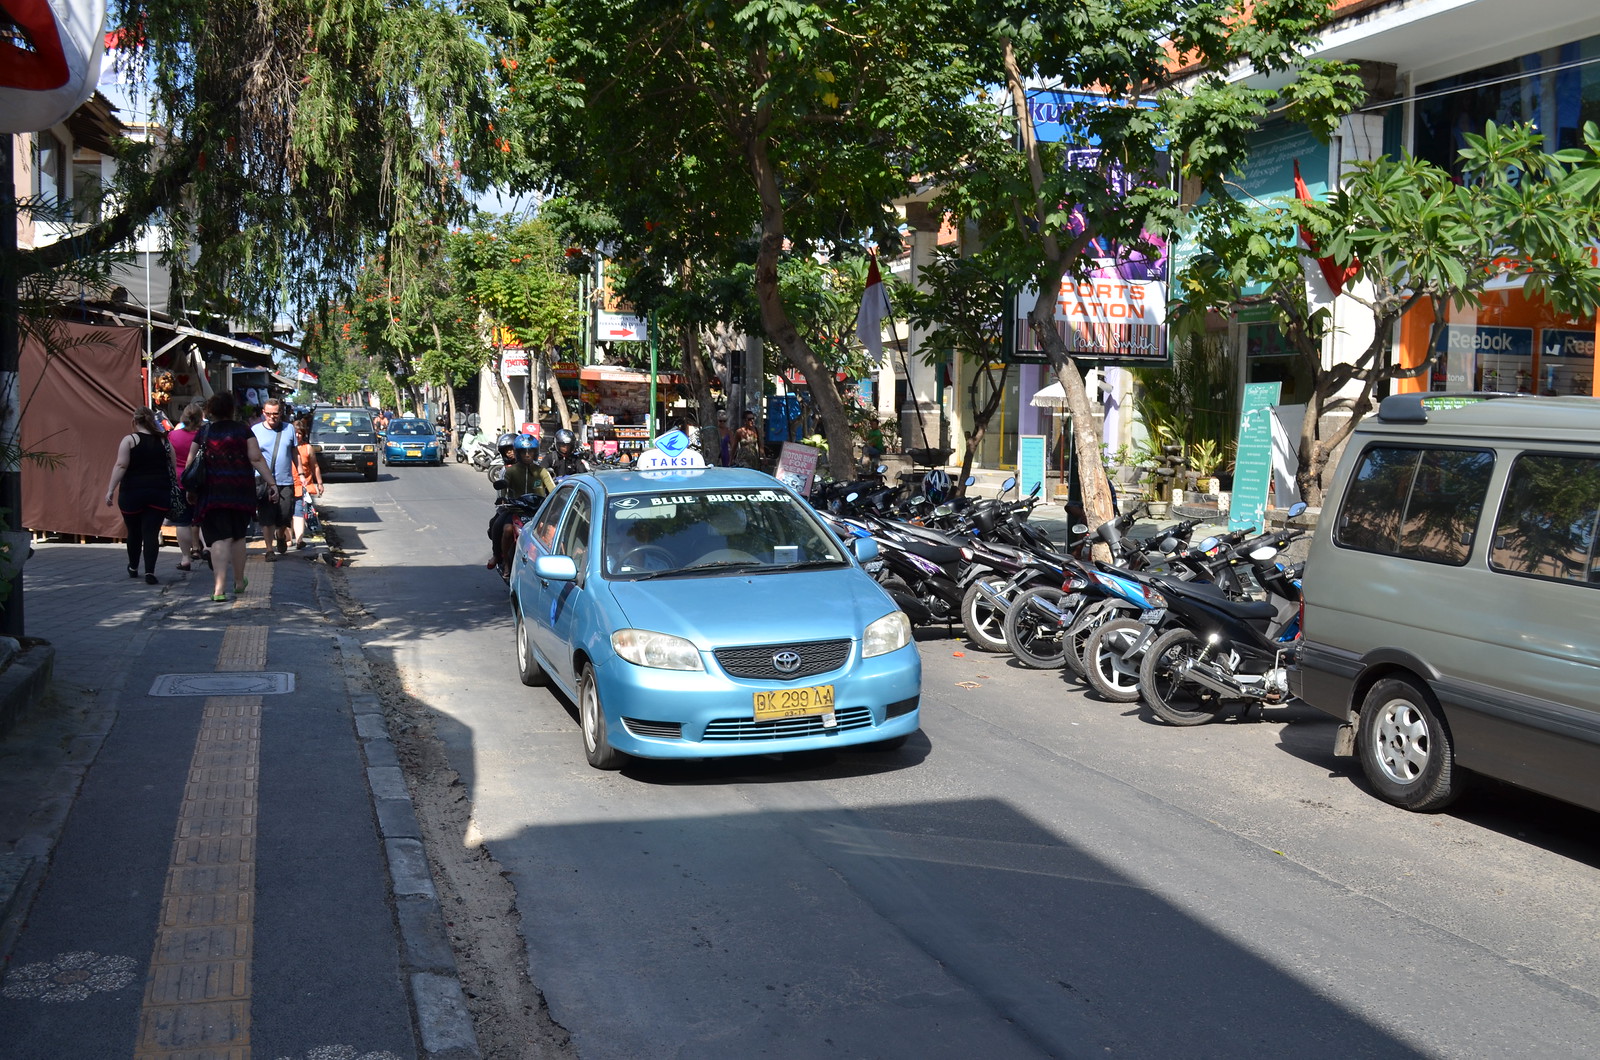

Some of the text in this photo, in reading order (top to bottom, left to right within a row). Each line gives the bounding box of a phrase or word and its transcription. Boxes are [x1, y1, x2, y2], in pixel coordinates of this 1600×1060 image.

[1059, 282, 1145, 300] PORTS
[1053, 301, 1145, 319] TATION
[1073, 329, 1159, 351] Paul Smith
[1448, 330, 1513, 351] Reebok
[1564, 336, 1594, 355] Ree
[651, 457, 695, 467] TAKSI
[783, 465, 812, 474] RENT
[789, 460, 807, 468] FOR
[651, 494, 792, 506] BLUE BIRD GROUP
[757, 688, 833, 711] DK 299 AA
